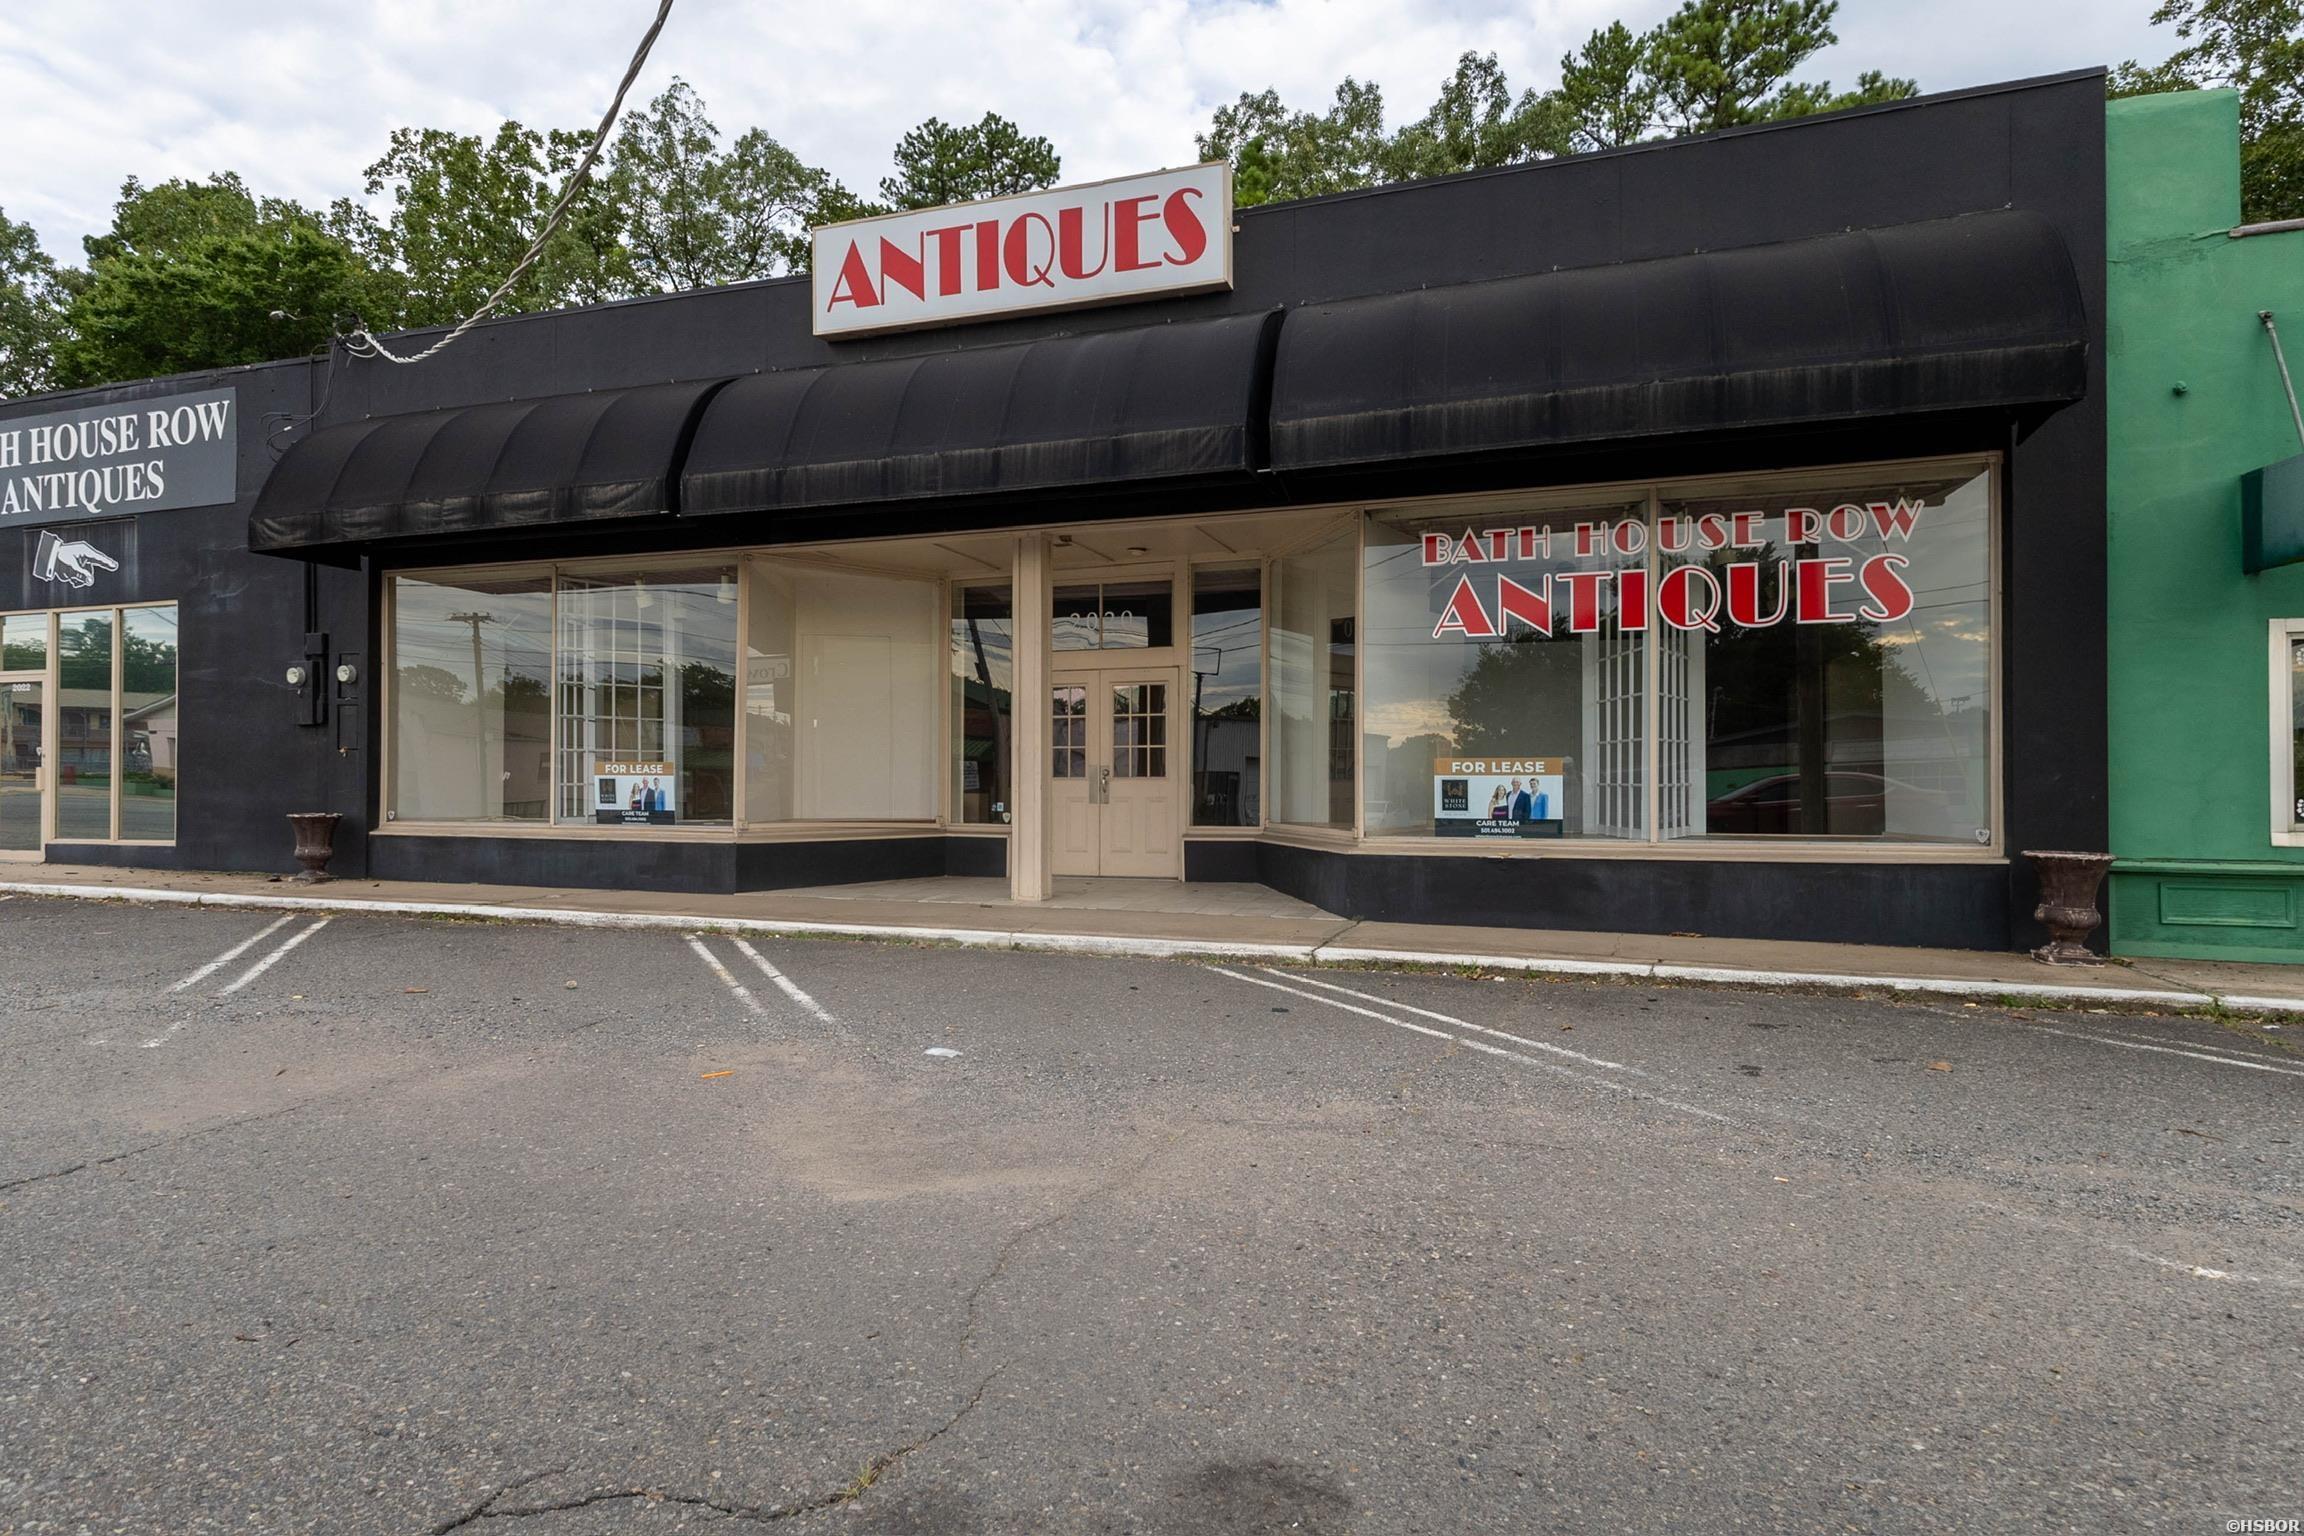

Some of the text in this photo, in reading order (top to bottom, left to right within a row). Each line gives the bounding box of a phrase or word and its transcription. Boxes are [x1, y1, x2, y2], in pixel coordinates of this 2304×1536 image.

[826, 187, 1208, 313] ANTIQUES
[28, 414, 140, 464] HOUSE
[146, 400, 230, 449] ROW
[1, 460, 164, 515] ANTIQUES
[1422, 496, 1925, 567] BATH HOUSE ROW
[1432, 553, 1914, 639] ANTIQUES
[605, 764, 664, 774] FOR LEASE
[1451, 761, 1545, 773] FOR LEASE
[1476, 820, 1520, 828] CARE TEAM
